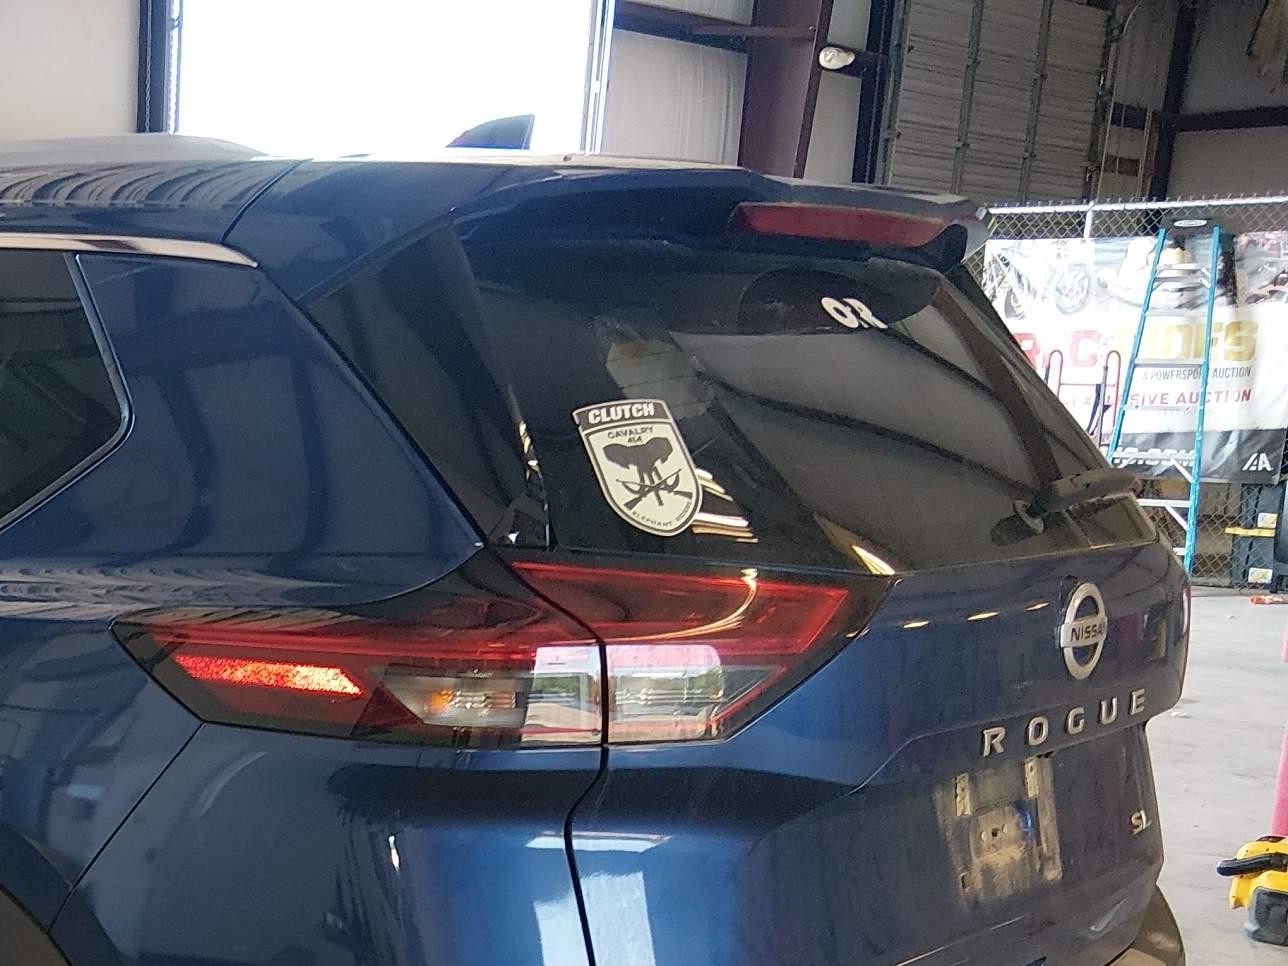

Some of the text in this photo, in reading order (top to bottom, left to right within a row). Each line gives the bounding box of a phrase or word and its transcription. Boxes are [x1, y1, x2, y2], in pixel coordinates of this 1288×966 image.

[1212, 366, 1251, 379] AUCTION
[588, 402, 655, 424] CLUTCH
[983, 689, 1146, 757] ROGUE
[1131, 809, 1152, 835] SL
